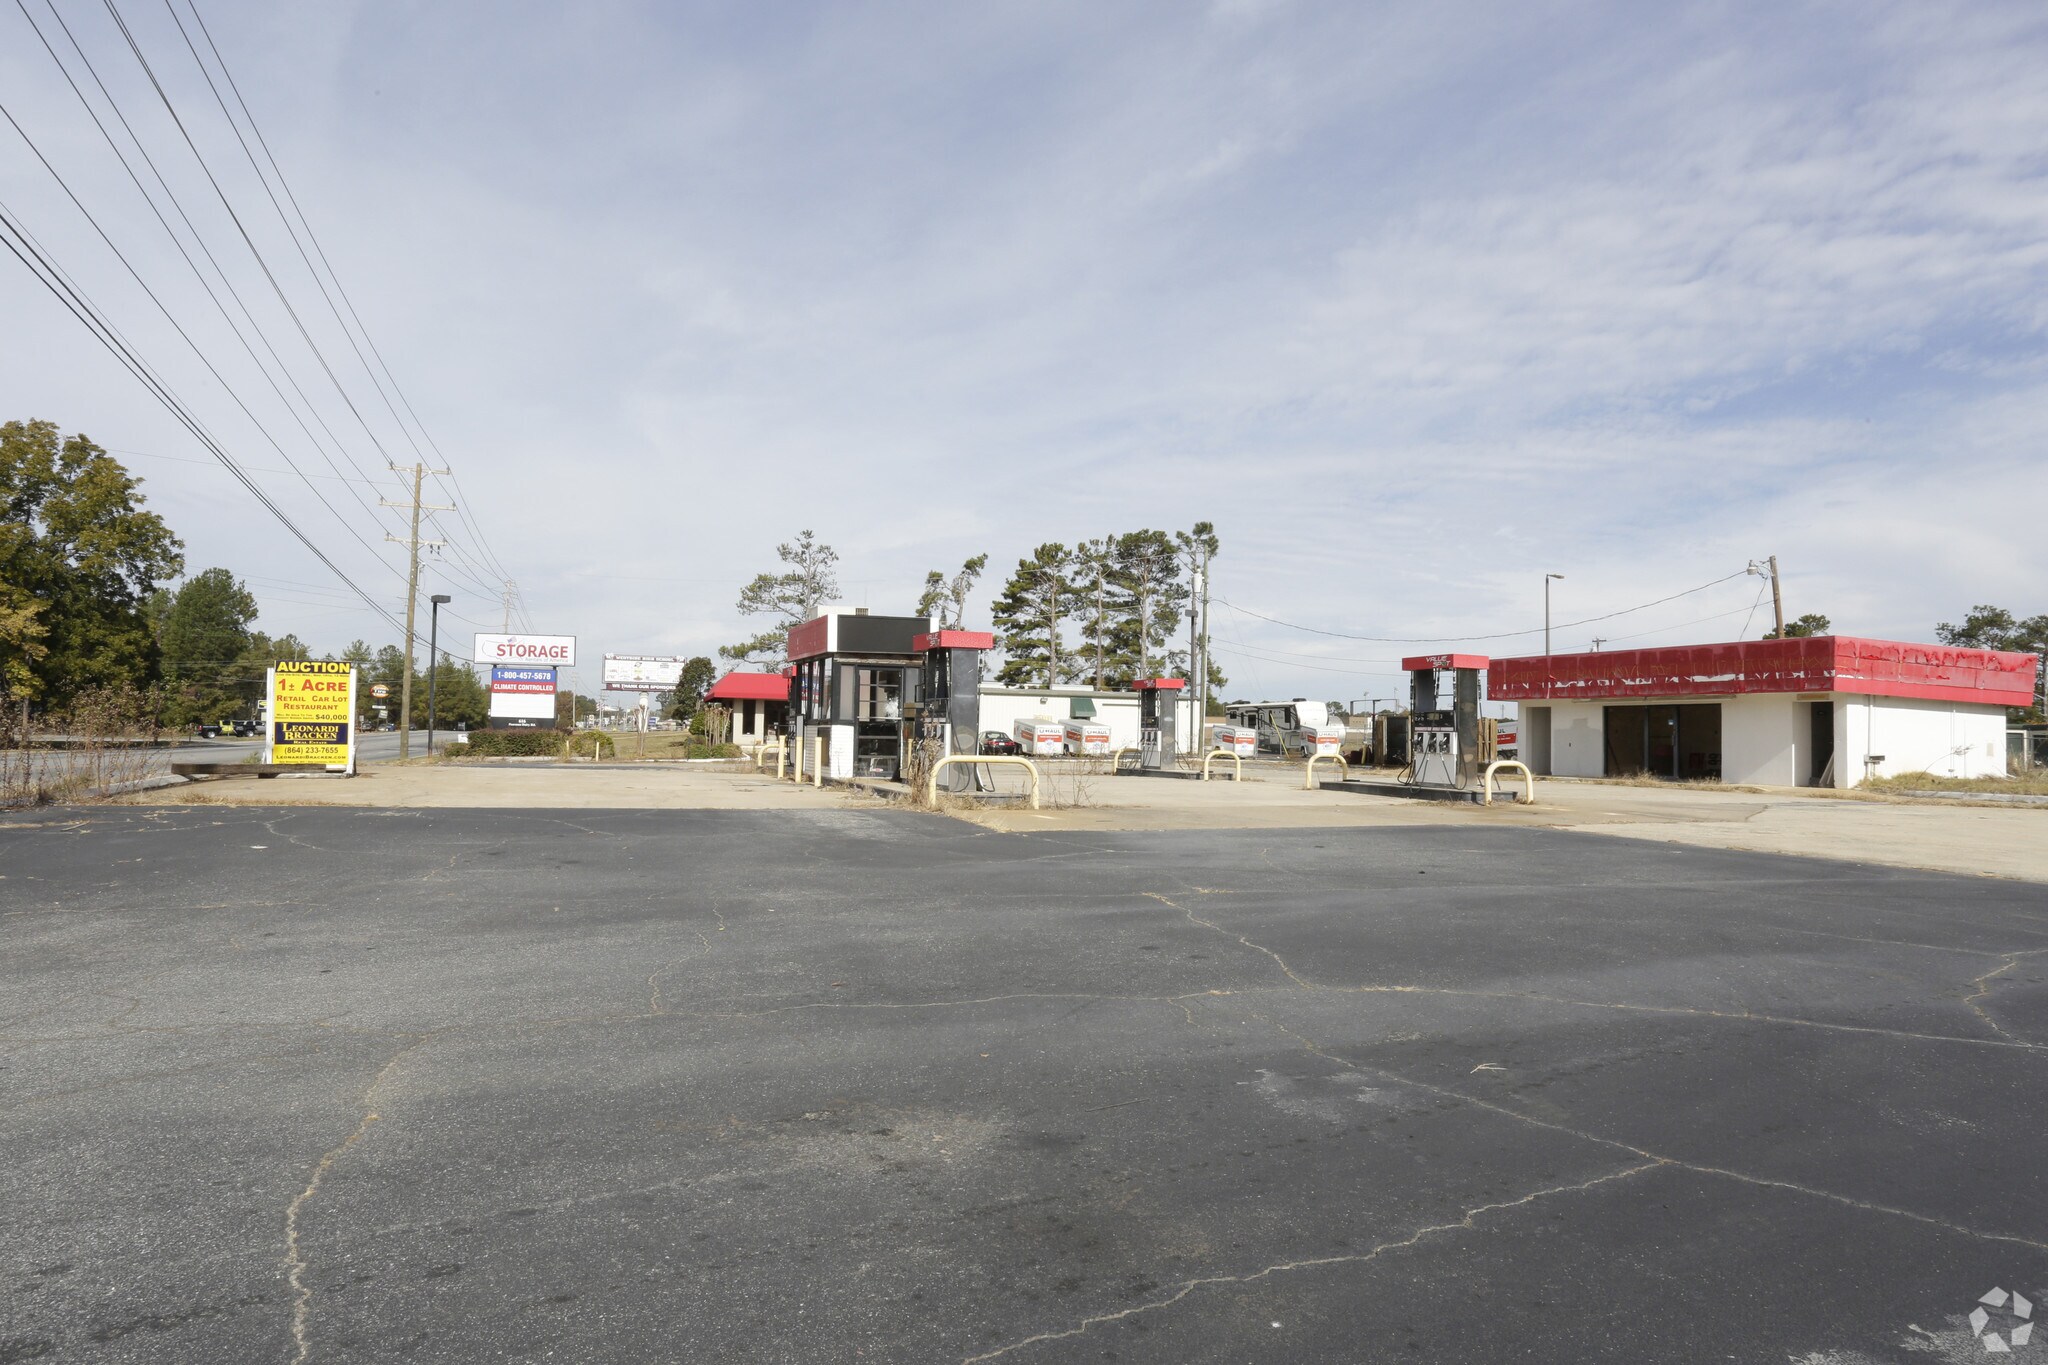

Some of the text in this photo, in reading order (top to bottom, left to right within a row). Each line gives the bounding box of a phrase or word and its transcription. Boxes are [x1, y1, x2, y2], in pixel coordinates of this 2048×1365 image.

[496, 644, 568, 658] STORAGE
[277, 662, 349, 673] AUCTION
[497, 671, 551, 680] 1-800-457-5678
[301, 679, 347, 691] ACRE
[282, 723, 339, 732] LEONARDI
[284, 731, 337, 741] BRACKEN
